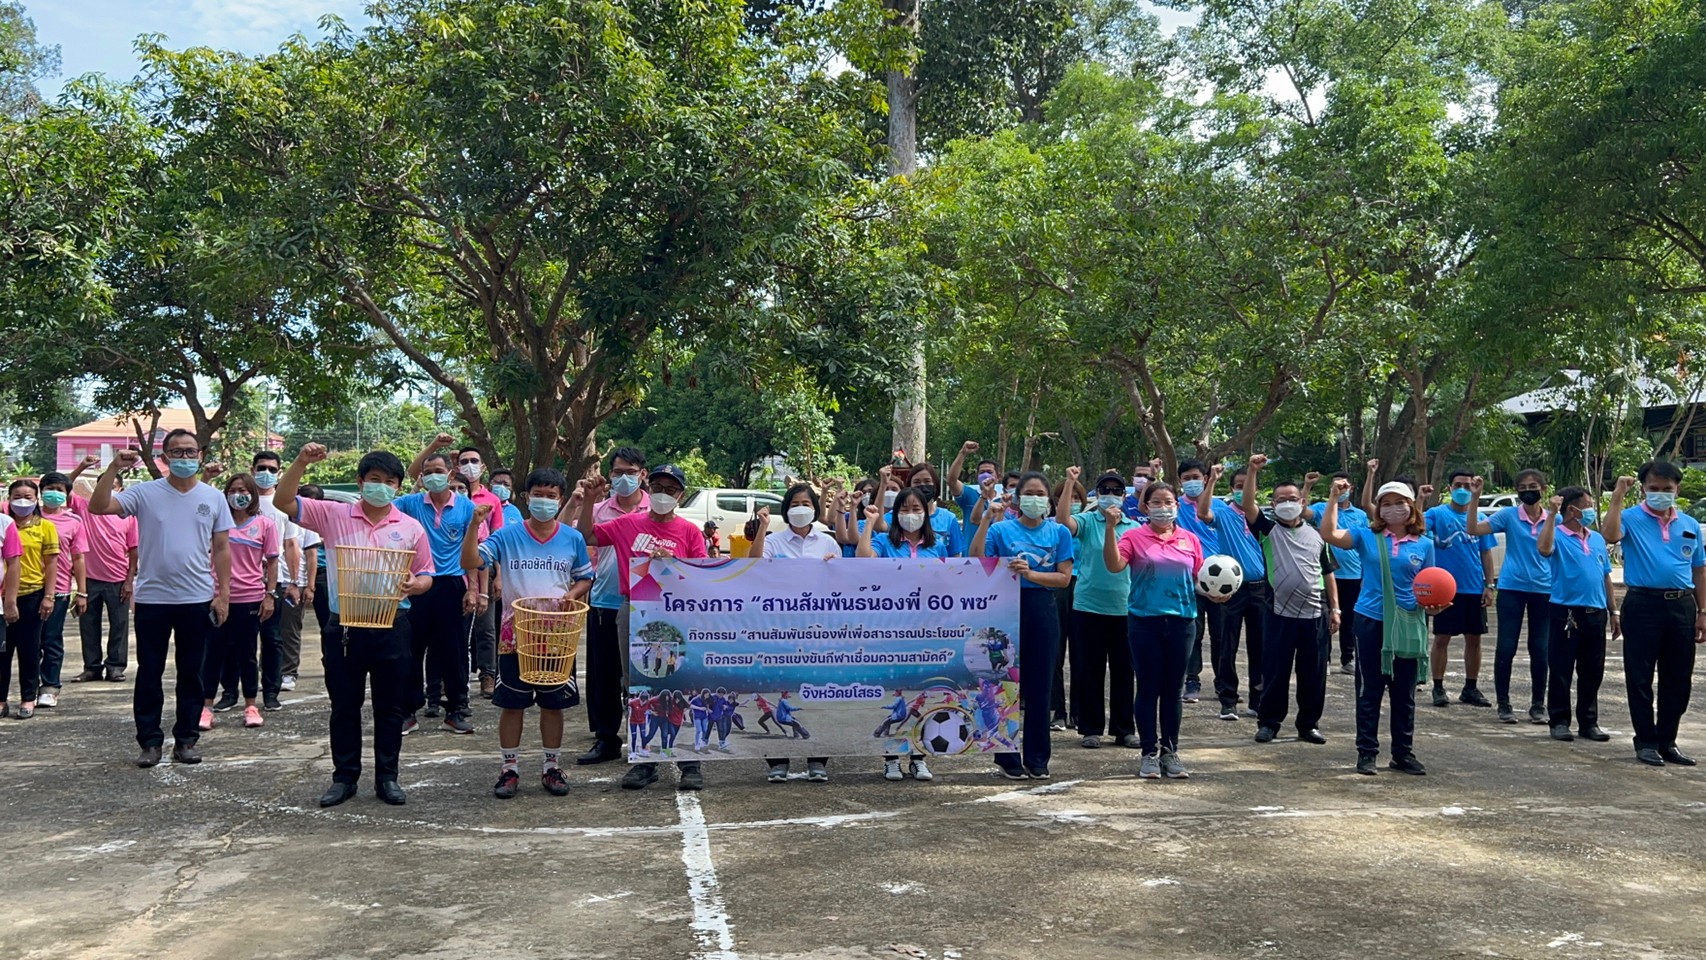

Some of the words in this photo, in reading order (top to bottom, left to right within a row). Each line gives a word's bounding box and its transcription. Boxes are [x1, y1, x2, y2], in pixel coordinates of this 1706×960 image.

[662, 592, 744, 612] โครงการ
[927, 594, 954, 611] 60
[688, 629, 737, 641] กิจกรรม
[705, 653, 753, 665] กิจกรรม
[802, 685, 882, 699] จังหวัดยโสธร
